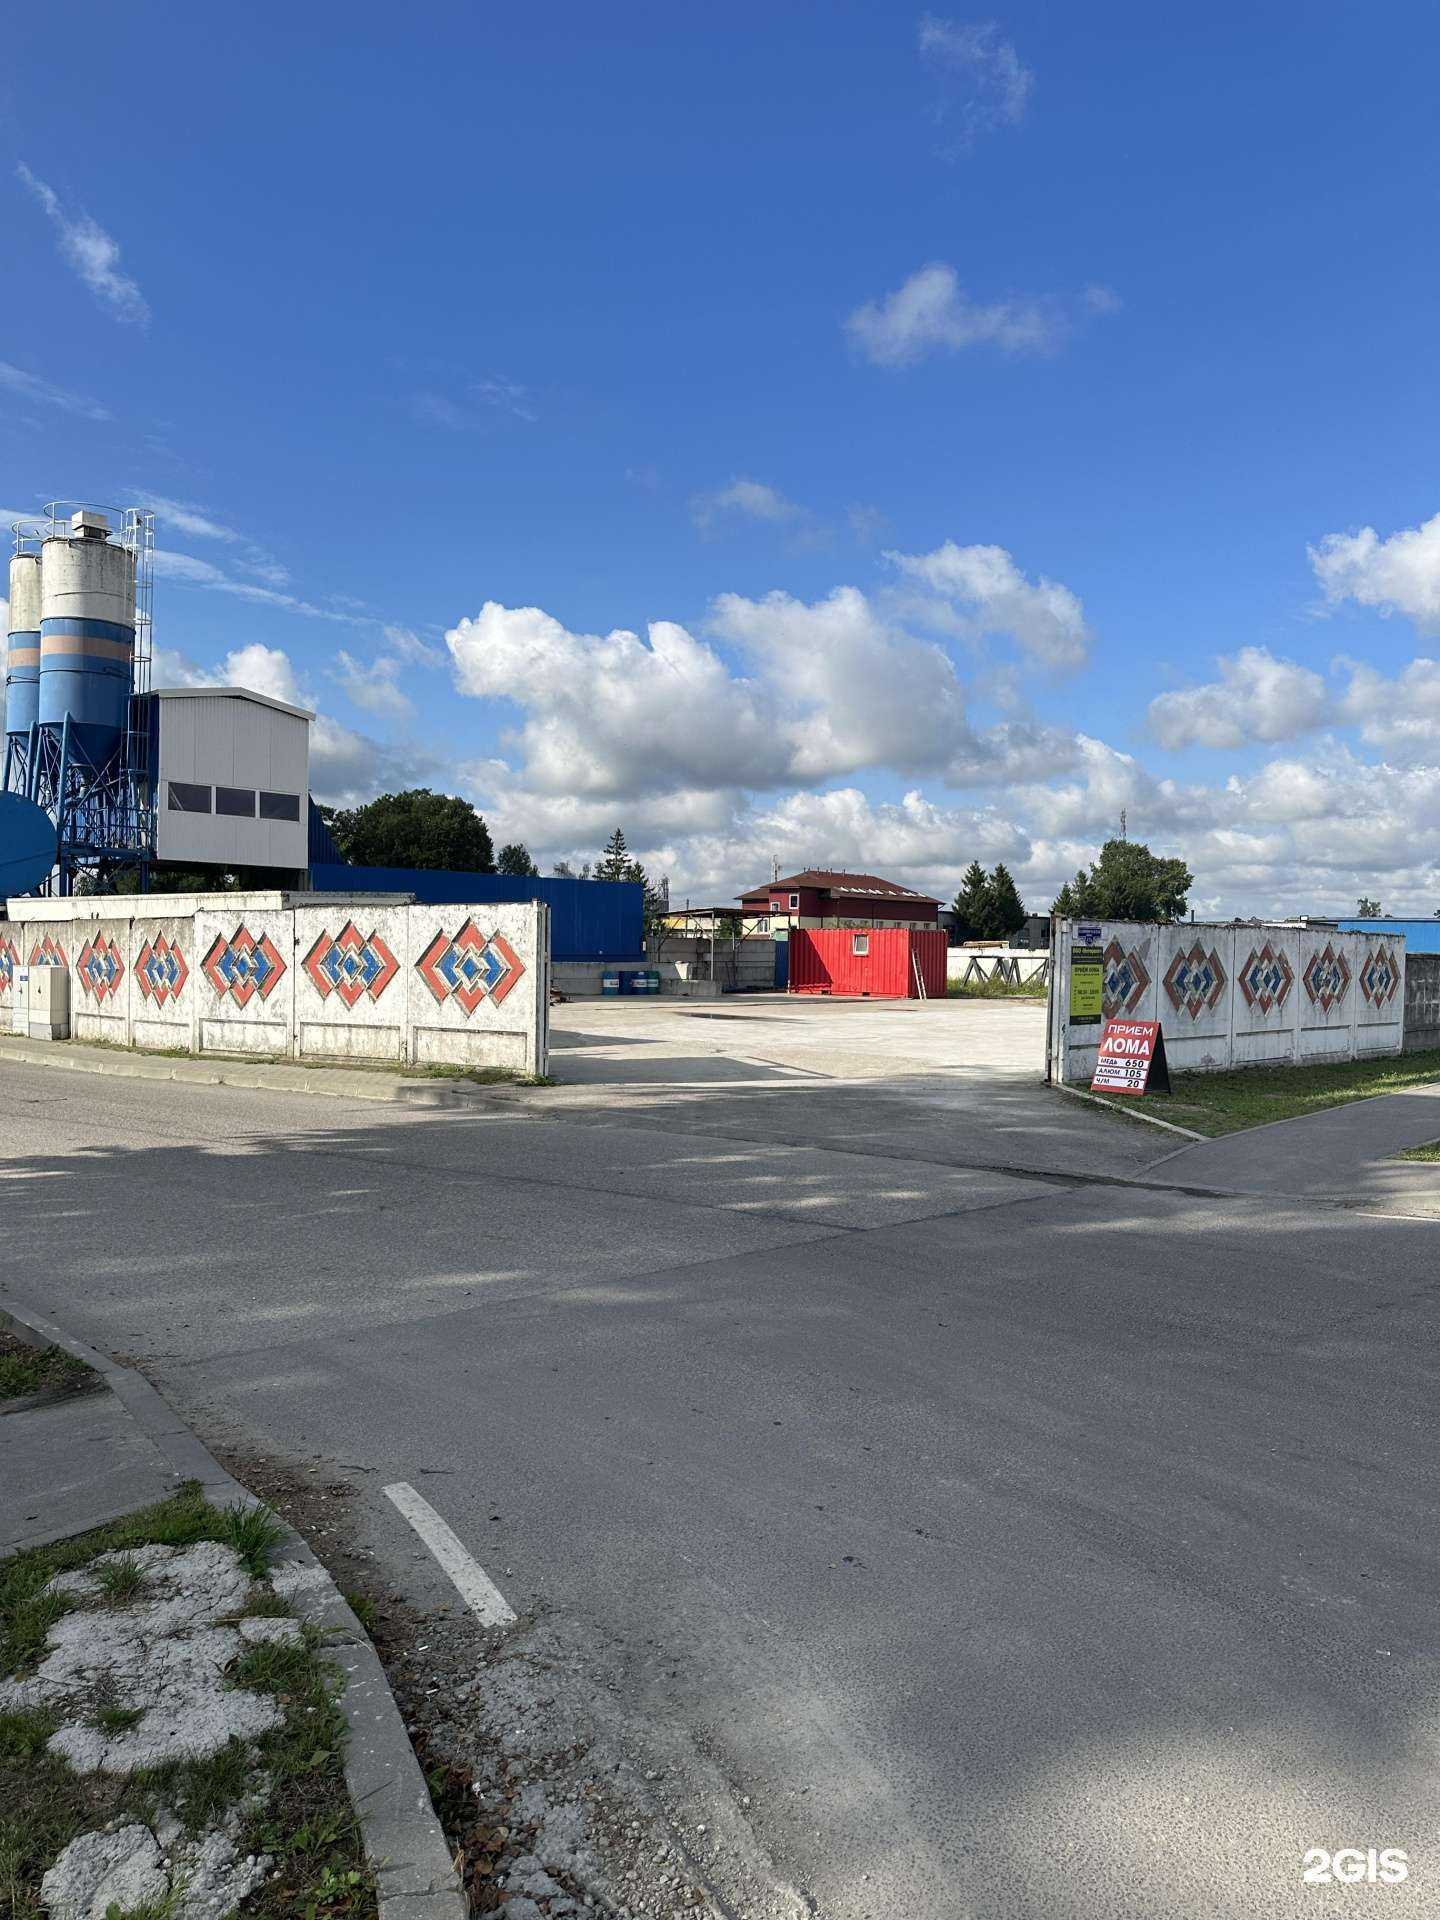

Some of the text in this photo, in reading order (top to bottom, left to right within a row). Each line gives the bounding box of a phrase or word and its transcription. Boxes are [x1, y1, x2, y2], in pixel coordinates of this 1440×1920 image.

[1107, 1024, 1154, 1036] ПРИЕМ
[1102, 1037, 1150, 1055] ЛОМА
[1100, 1057, 1144, 1068] МЕДЬ 650
[1124, 1069, 1142, 1078] 105
[1126, 1079, 1140, 1088] 20
